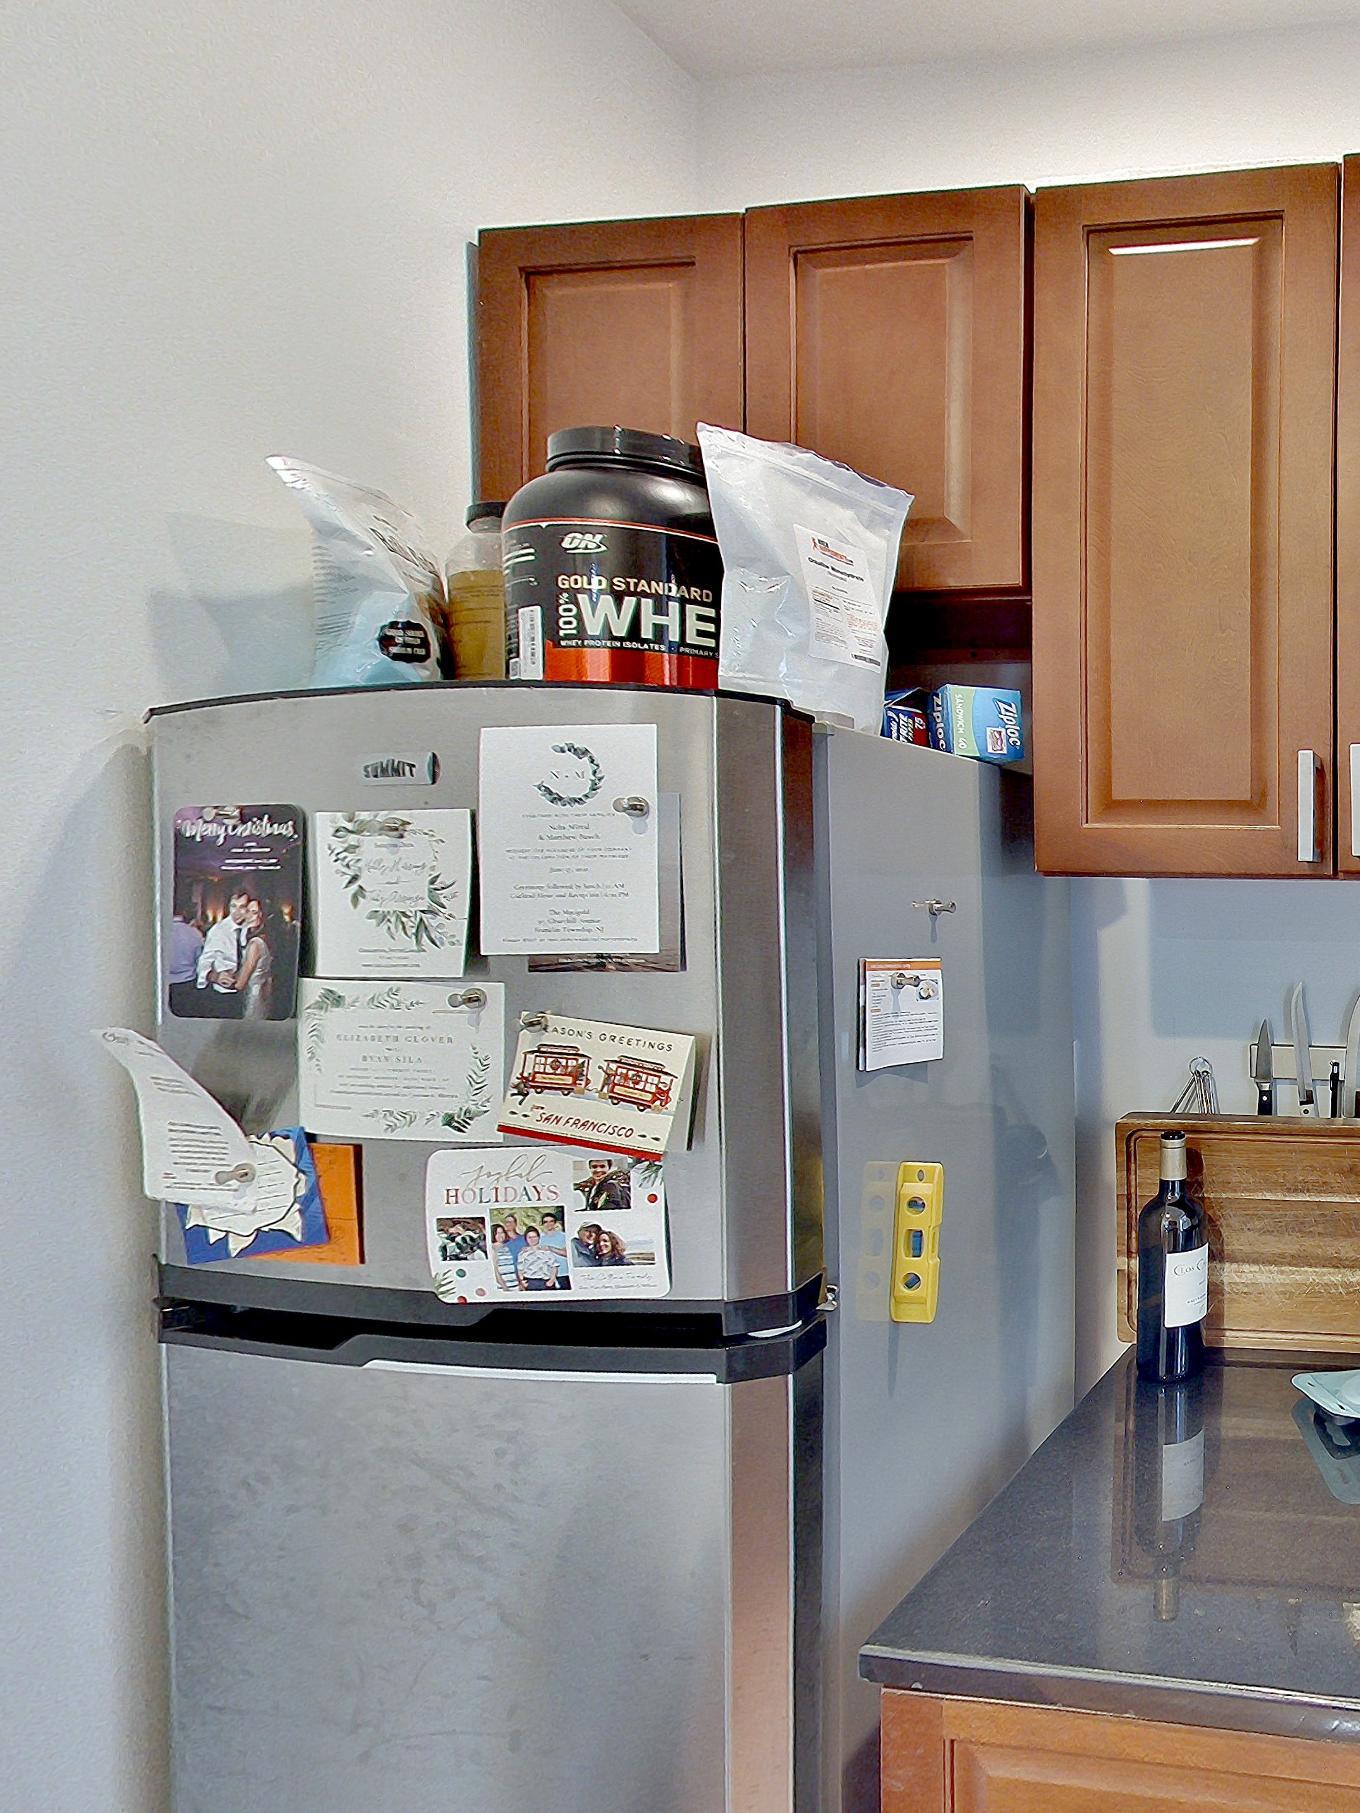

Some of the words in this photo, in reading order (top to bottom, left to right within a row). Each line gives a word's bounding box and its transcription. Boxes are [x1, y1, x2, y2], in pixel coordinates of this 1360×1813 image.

[561, 532, 608, 553] ON
[557, 574, 607, 590] GOLD
[612, 577, 713, 603] STANDARD
[557, 592, 578, 637] 100%
[577, 593, 716, 648] WHE
[584, 640, 621, 648] PROTEIN
[622, 641, 666, 651] ISOLATES
[679, 646, 713, 657] PRIMARY
[933, 693, 946, 751] Ziploc
[954, 694, 965, 734] SANDWICH
[995, 700, 1021, 747] Ziploc
[363, 758, 417, 778] SUMMIT
[598, 1032, 674, 1053] GREETINGS
[535, 1111, 563, 1126] SAN
[563, 1116, 635, 1138] FRANCISCO
[444, 1183, 560, 1205] HOLIDAYS
